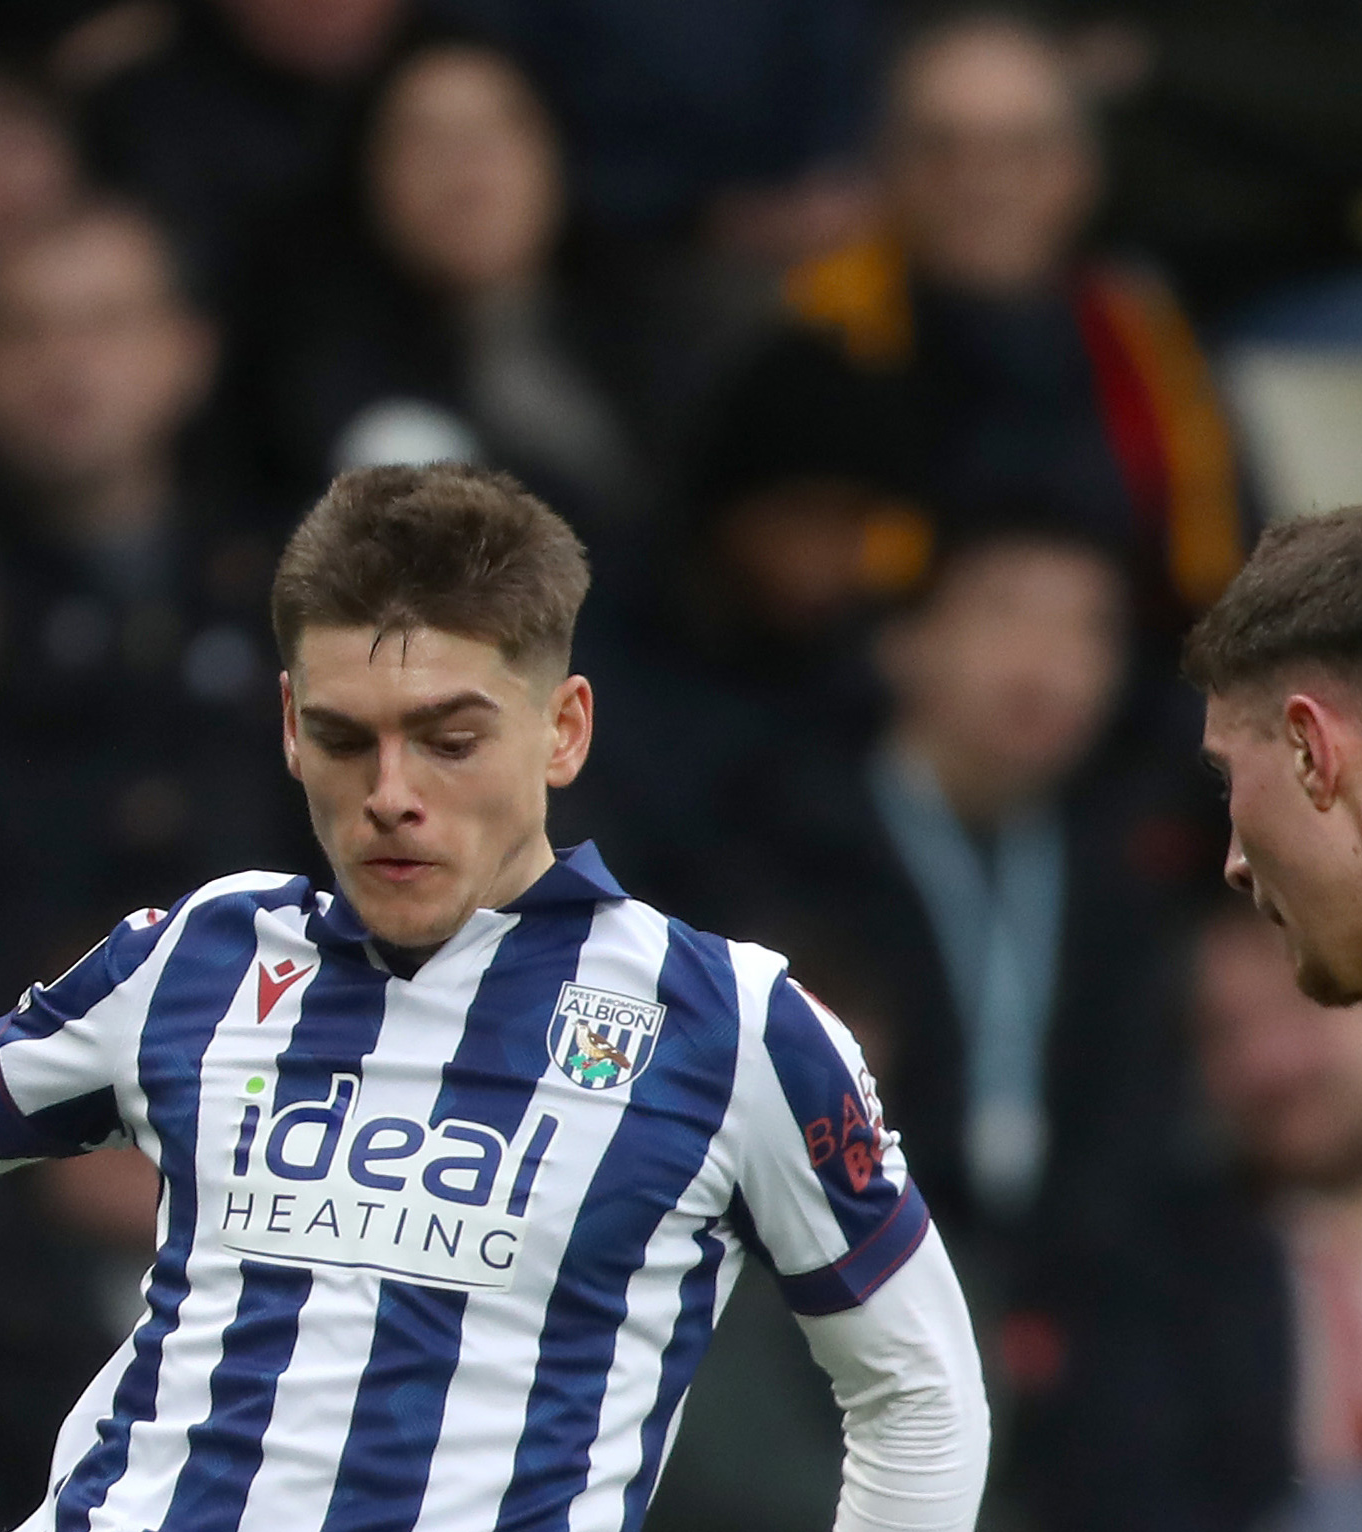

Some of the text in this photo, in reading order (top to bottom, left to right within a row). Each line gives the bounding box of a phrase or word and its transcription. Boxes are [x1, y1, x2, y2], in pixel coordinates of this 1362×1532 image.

[563, 998, 655, 1032] ALBION
[233, 1076, 559, 1217] ideal
[222, 1192, 518, 1270] HEATING
